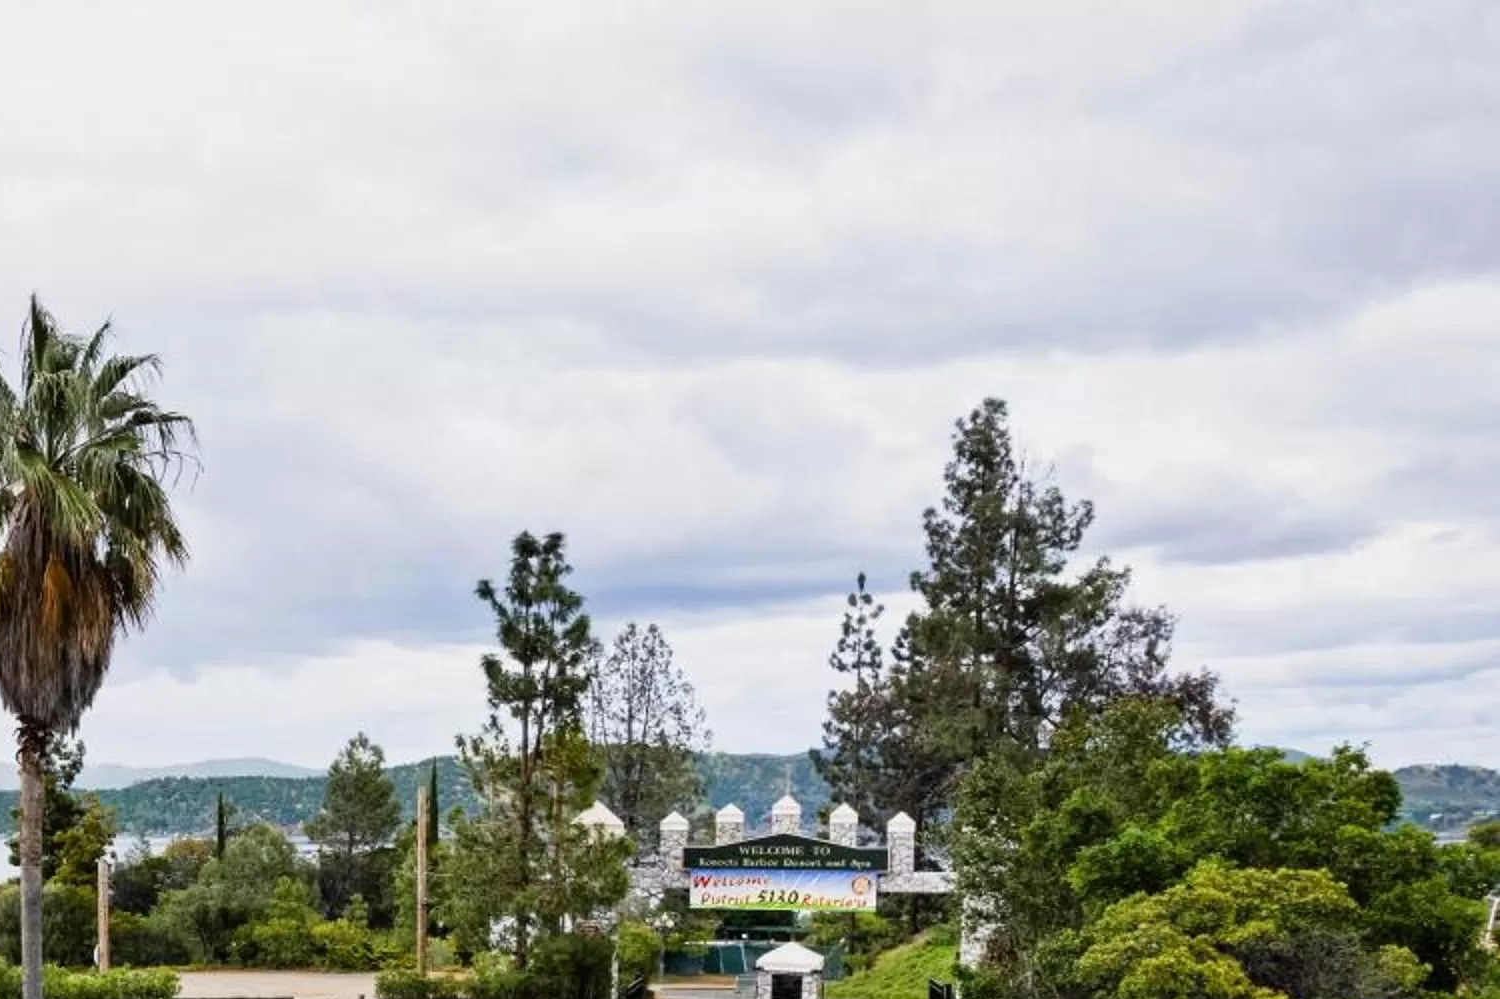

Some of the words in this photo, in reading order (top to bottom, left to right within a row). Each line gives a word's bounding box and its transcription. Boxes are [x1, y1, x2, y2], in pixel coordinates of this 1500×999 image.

[739, 845, 804, 855] WELCOME
[813, 846, 831, 855] TO
[693, 874, 772, 888] Welcome
